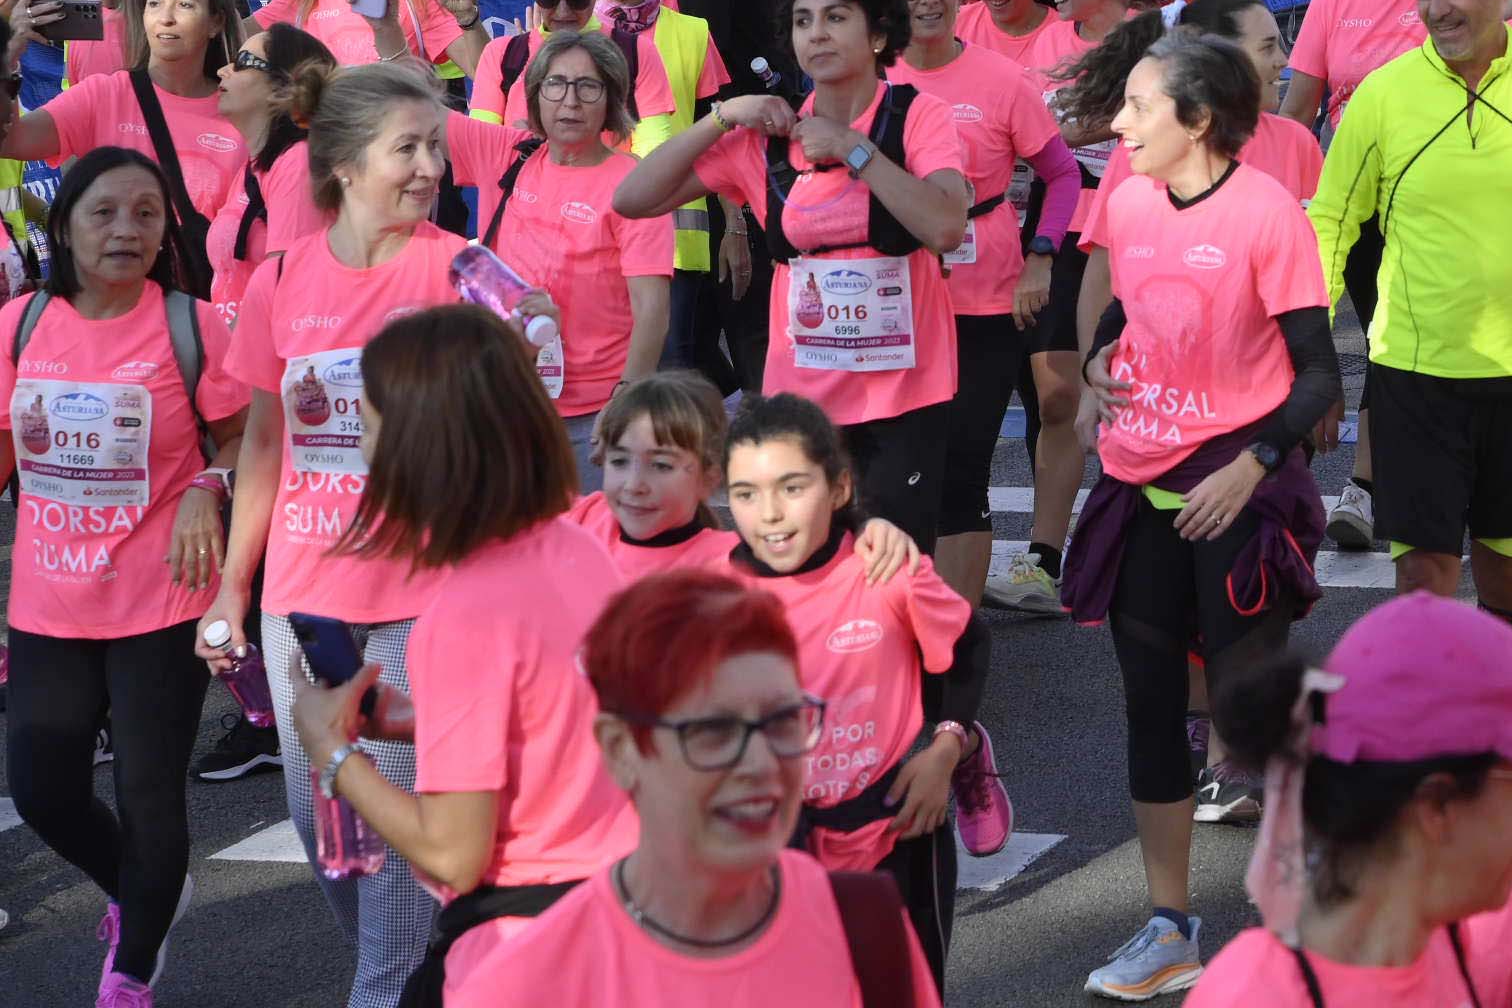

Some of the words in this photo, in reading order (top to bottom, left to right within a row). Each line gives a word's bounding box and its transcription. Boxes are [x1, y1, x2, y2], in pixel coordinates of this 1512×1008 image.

[824, 279, 869, 289] ASTURIANA
[827, 304, 868, 320] 016
[834, 325, 861, 335] 6996
[805, 352, 838, 363] OYSHO
[52, 401, 105, 415] ASTURIANA
[334, 397, 361, 414] 01
[54, 430, 101, 450] 016
[59, 453, 95, 465] 11669
[304, 452, 345, 465] OYSHO
[74, 470, 85, 478] LA
[86, 471, 114, 479] MUJER
[285, 471, 366, 495] DORS
[93, 488, 139, 497] Santander
[284, 502, 342, 537] SUM
[832, 721, 876, 744] POR
[806, 747, 878, 777] TODAS
